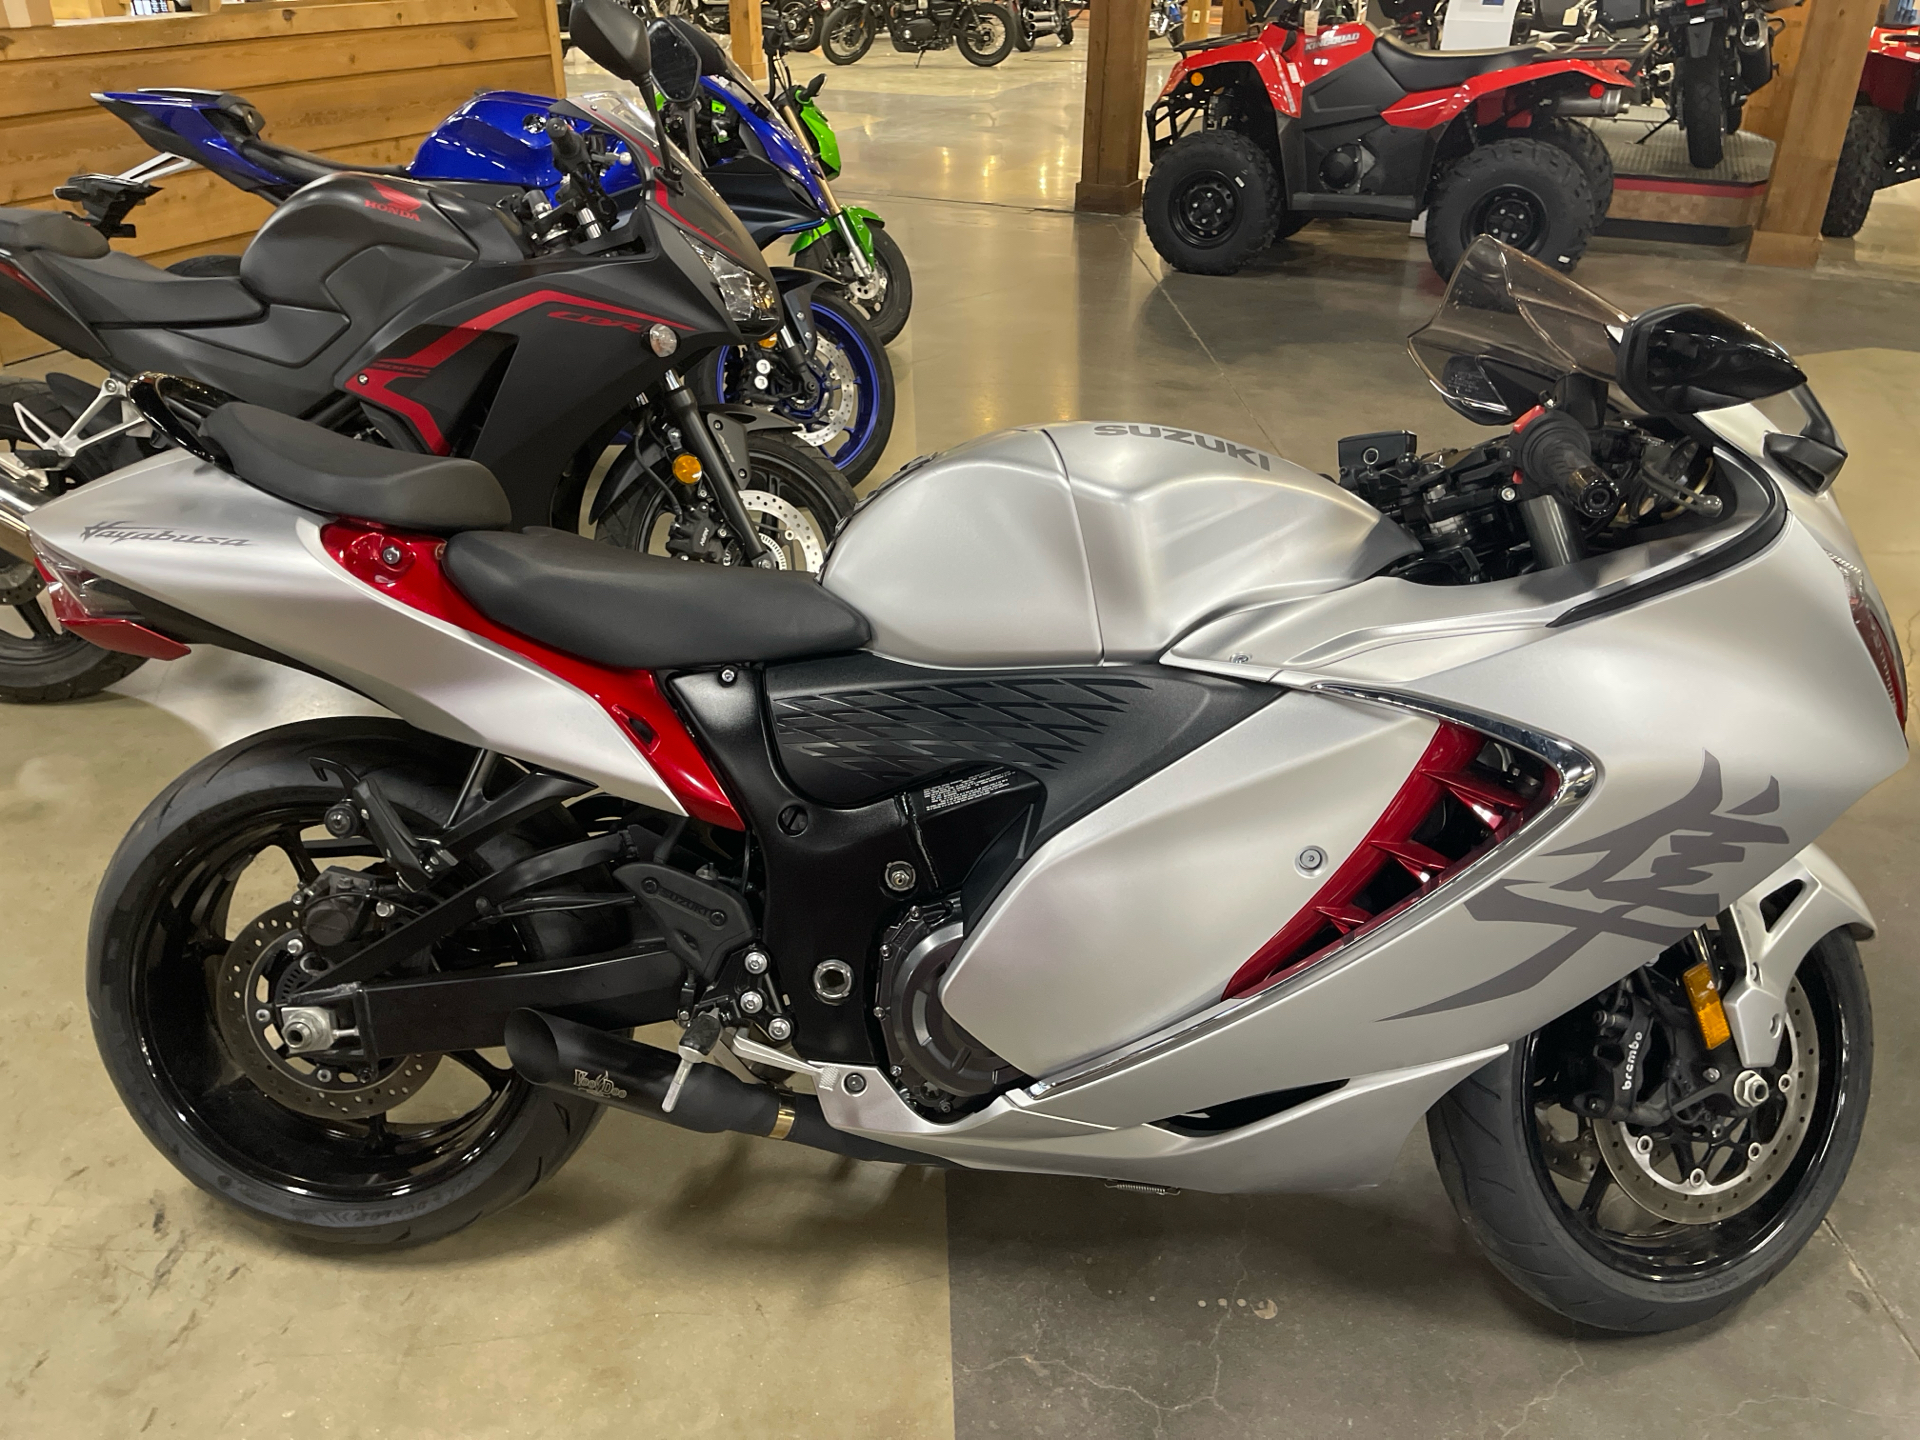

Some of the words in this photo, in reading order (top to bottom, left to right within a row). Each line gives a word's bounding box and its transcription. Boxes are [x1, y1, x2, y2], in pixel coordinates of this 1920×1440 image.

[365, 199, 421, 222] HONDA
[1094, 425, 1270, 472] SUZUKI
[80, 520, 257, 547] Hayabusa
[660, 887, 710, 916] SUZUKI
[1621, 1031, 1643, 1091] brembo
